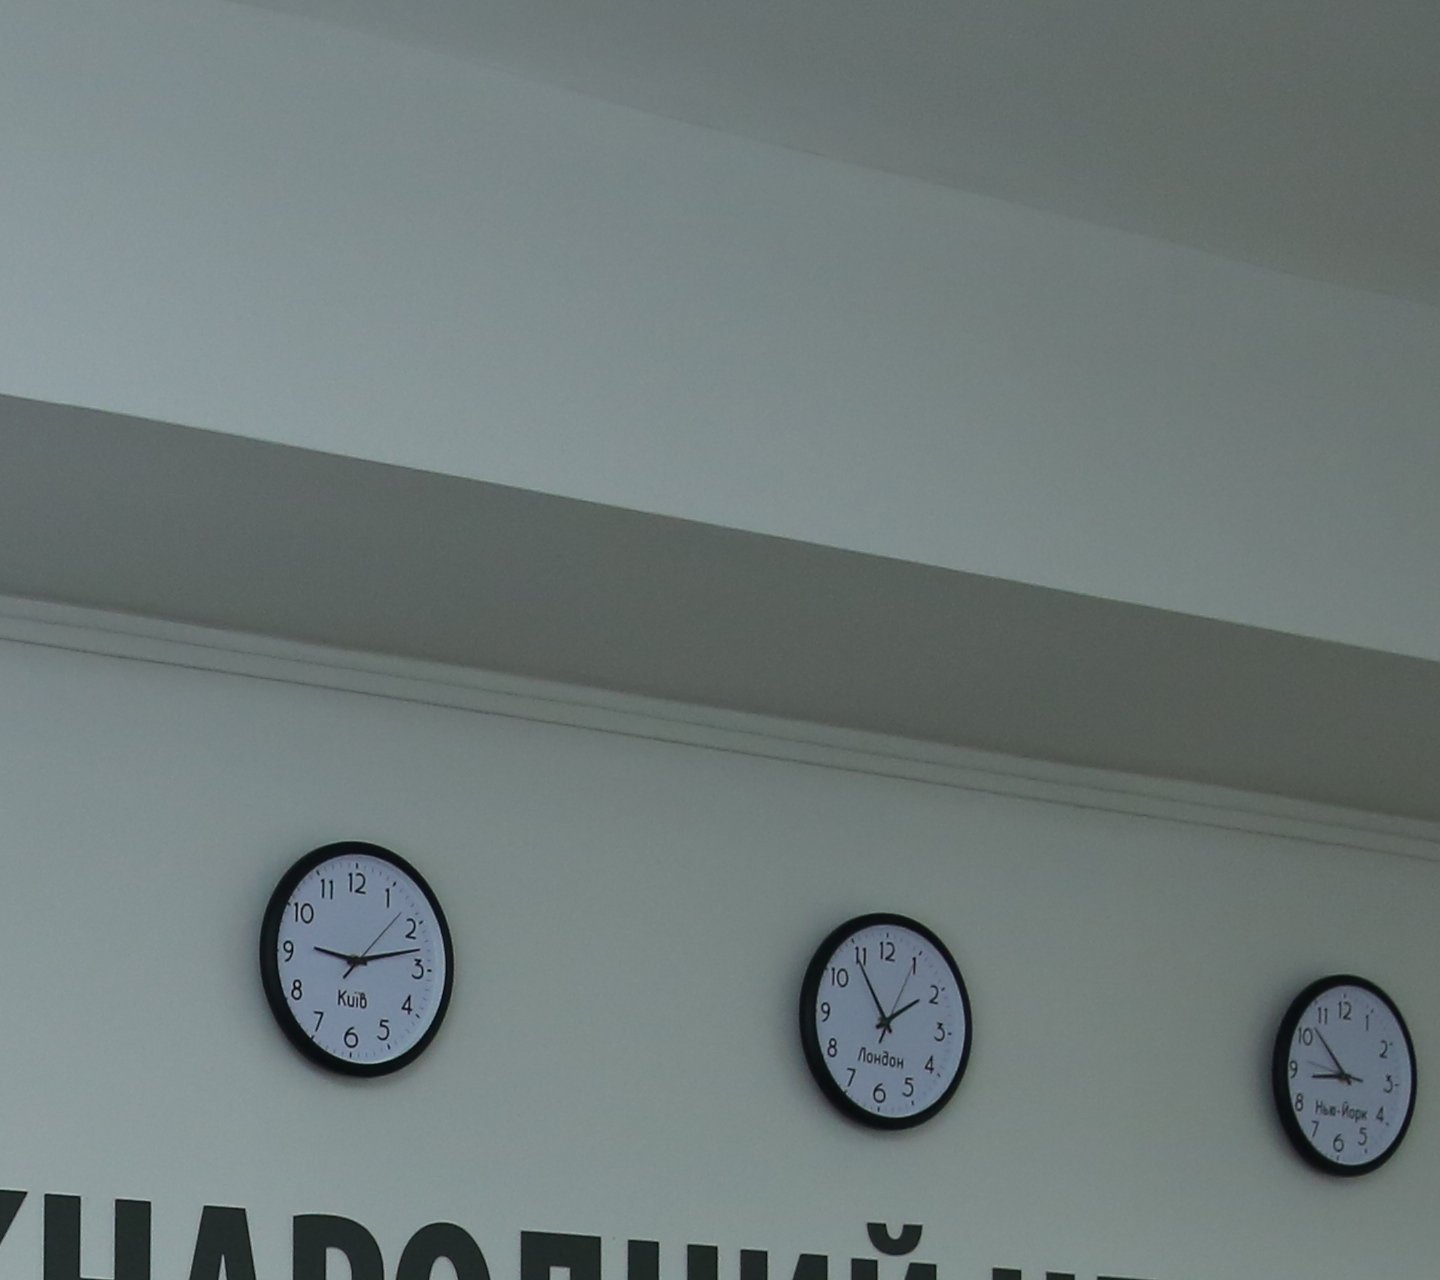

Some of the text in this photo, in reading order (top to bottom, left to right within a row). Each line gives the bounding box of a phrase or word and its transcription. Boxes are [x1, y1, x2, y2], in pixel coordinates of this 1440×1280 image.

[321, 879, 333, 899] 11
[348, 873, 366, 894] 12
[385, 888, 390, 908] 1
[294, 902, 314, 924] 10
[405, 918, 416, 939] 2
[283, 941, 294, 961] 9
[855, 947, 867, 966] 11
[880, 942, 895, 962] 12
[411, 959, 423, 979] 3
[912, 957, 916, 975] 1
[831, 968, 849, 987] 10
[291, 979, 302, 1000] 8
[929, 985, 939, 1004] 2
[401, 995, 412, 1015] 4
[821, 1002, 830, 1022] 9
[1338, 1002, 1351, 1020] 12
[313, 1011, 324, 1032] 7
[1318, 1007, 1328, 1024] 11
[1365, 1014, 1369, 1031] 1
[344, 1027, 358, 1048] 6
[377, 1019, 389, 1040] 5
[934, 1022, 945, 1042] 3
[1298, 1028, 1313, 1046] 10
[827, 1038, 837, 1058] 8
[858, 1047, 904, 1068] Лондон
[1379, 1040, 1388, 1059] 2
[925, 1056, 934, 1073] 4
[1288, 1061, 1297, 1078] 9
[846, 1068, 856, 1087] 7
[902, 1077, 914, 1097] 5
[1384, 1075, 1393, 1093] 3
[873, 1083, 886, 1103] 6
[1295, 1093, 1303, 1111] 8
[1376, 1106, 1384, 1123] 4
[1311, 1121, 1319, 1138] 7
[1358, 1127, 1367, 1145] 5
[1333, 1134, 1344, 1152] 6
